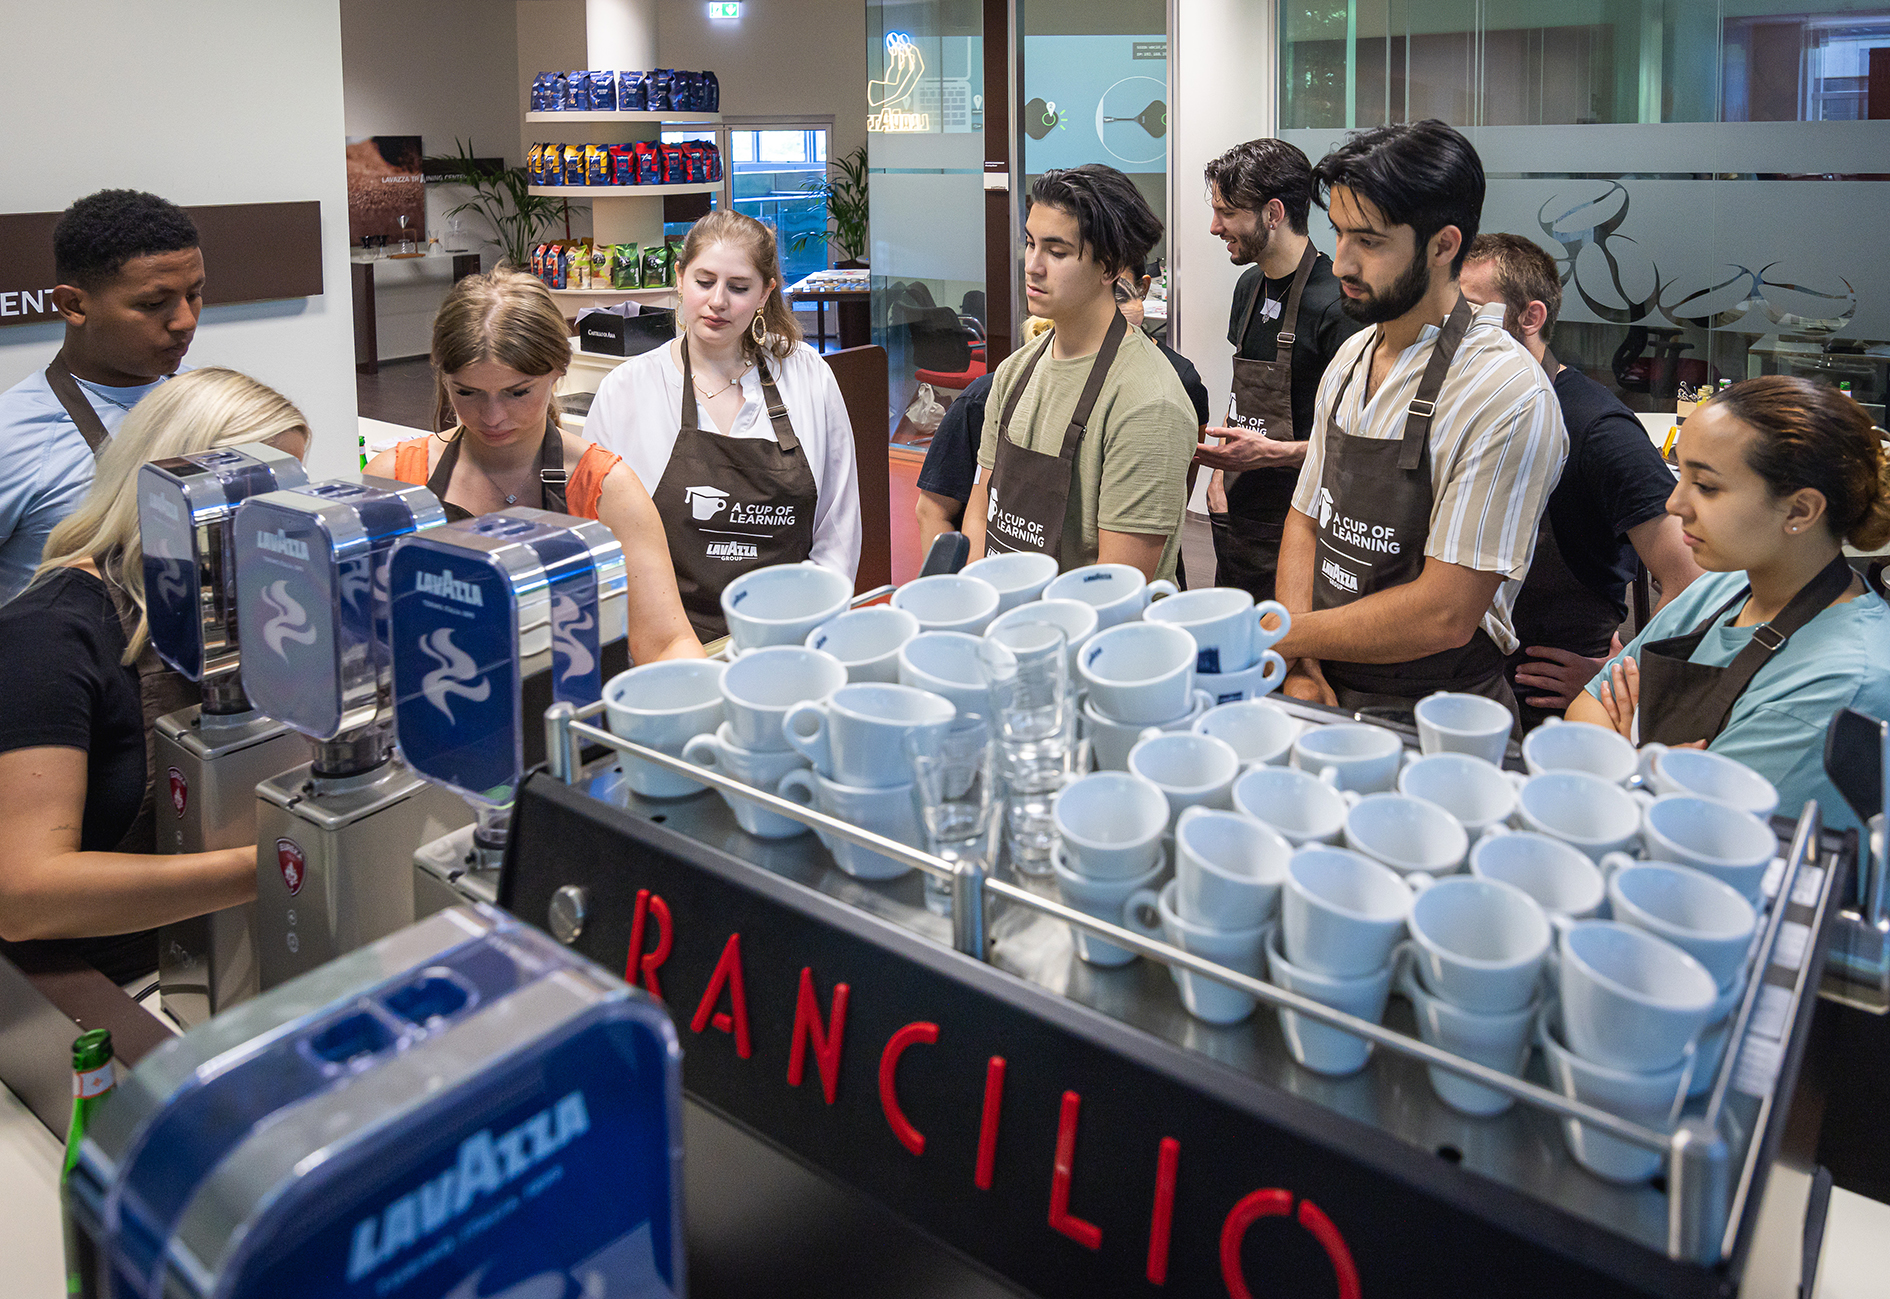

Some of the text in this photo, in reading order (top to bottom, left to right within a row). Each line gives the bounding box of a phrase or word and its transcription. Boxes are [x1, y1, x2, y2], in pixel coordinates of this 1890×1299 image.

[381, 176, 410, 184] LAVAZZA
[1248, 417, 1265, 427] OF
[729, 512, 796, 526] LEARNING
[731, 502, 794, 516] A CUP OF
[997, 508, 1044, 534] A CUP OF
[997, 518, 1045, 548] LEARNING
[1333, 512, 1395, 540] A CUP OF
[1333, 523, 1401, 555] LEARNING
[257, 528, 310, 561] LAVAZZA
[706, 541, 758, 557] LAVAZZA
[416, 569, 484, 607] LAVAZZA
[1321, 559, 1359, 591] LAVAZZA
[625, 889, 1361, 1299] RANCILIO
[348, 1089, 591, 1286] LAVAZZA
